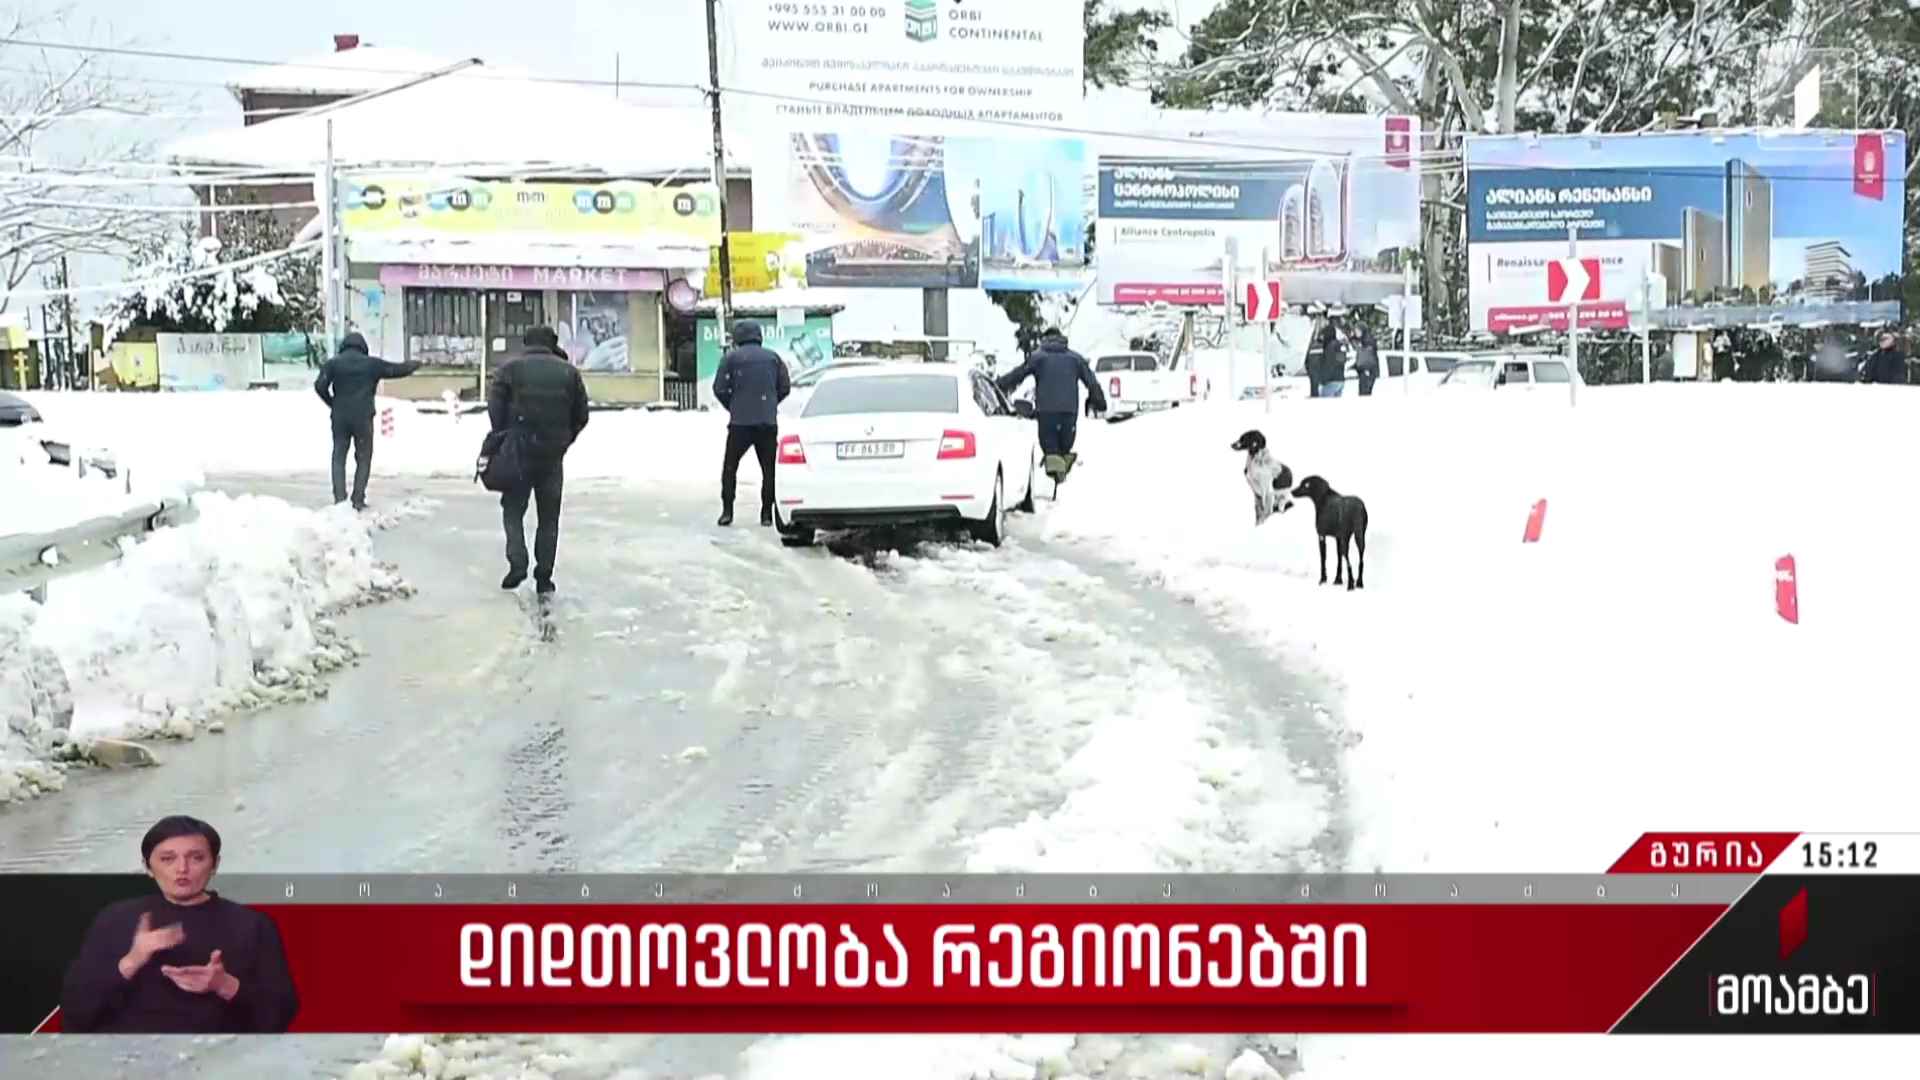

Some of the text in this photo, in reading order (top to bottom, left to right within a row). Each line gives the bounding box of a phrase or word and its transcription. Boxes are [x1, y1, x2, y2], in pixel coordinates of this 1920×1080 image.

[850, 6, 866, 17] 00
[870, 7, 887, 18] 00
[949, 9, 982, 21] ORBI
[767, 20, 869, 33] WWW.ORBI.GE
[949, 27, 1043, 42] CONTINENTAL
[808, 81, 1033, 97] PURCHASE APARTMENTS FOR OWNERSHIP
[1485, 186, 1653, 205] ალიანს რენესანსი
[1121, 227, 1216, 238] Alliance Centropolis
[1497, 256, 1545, 268] Renaissa
[533, 266, 627, 285] MARKET
